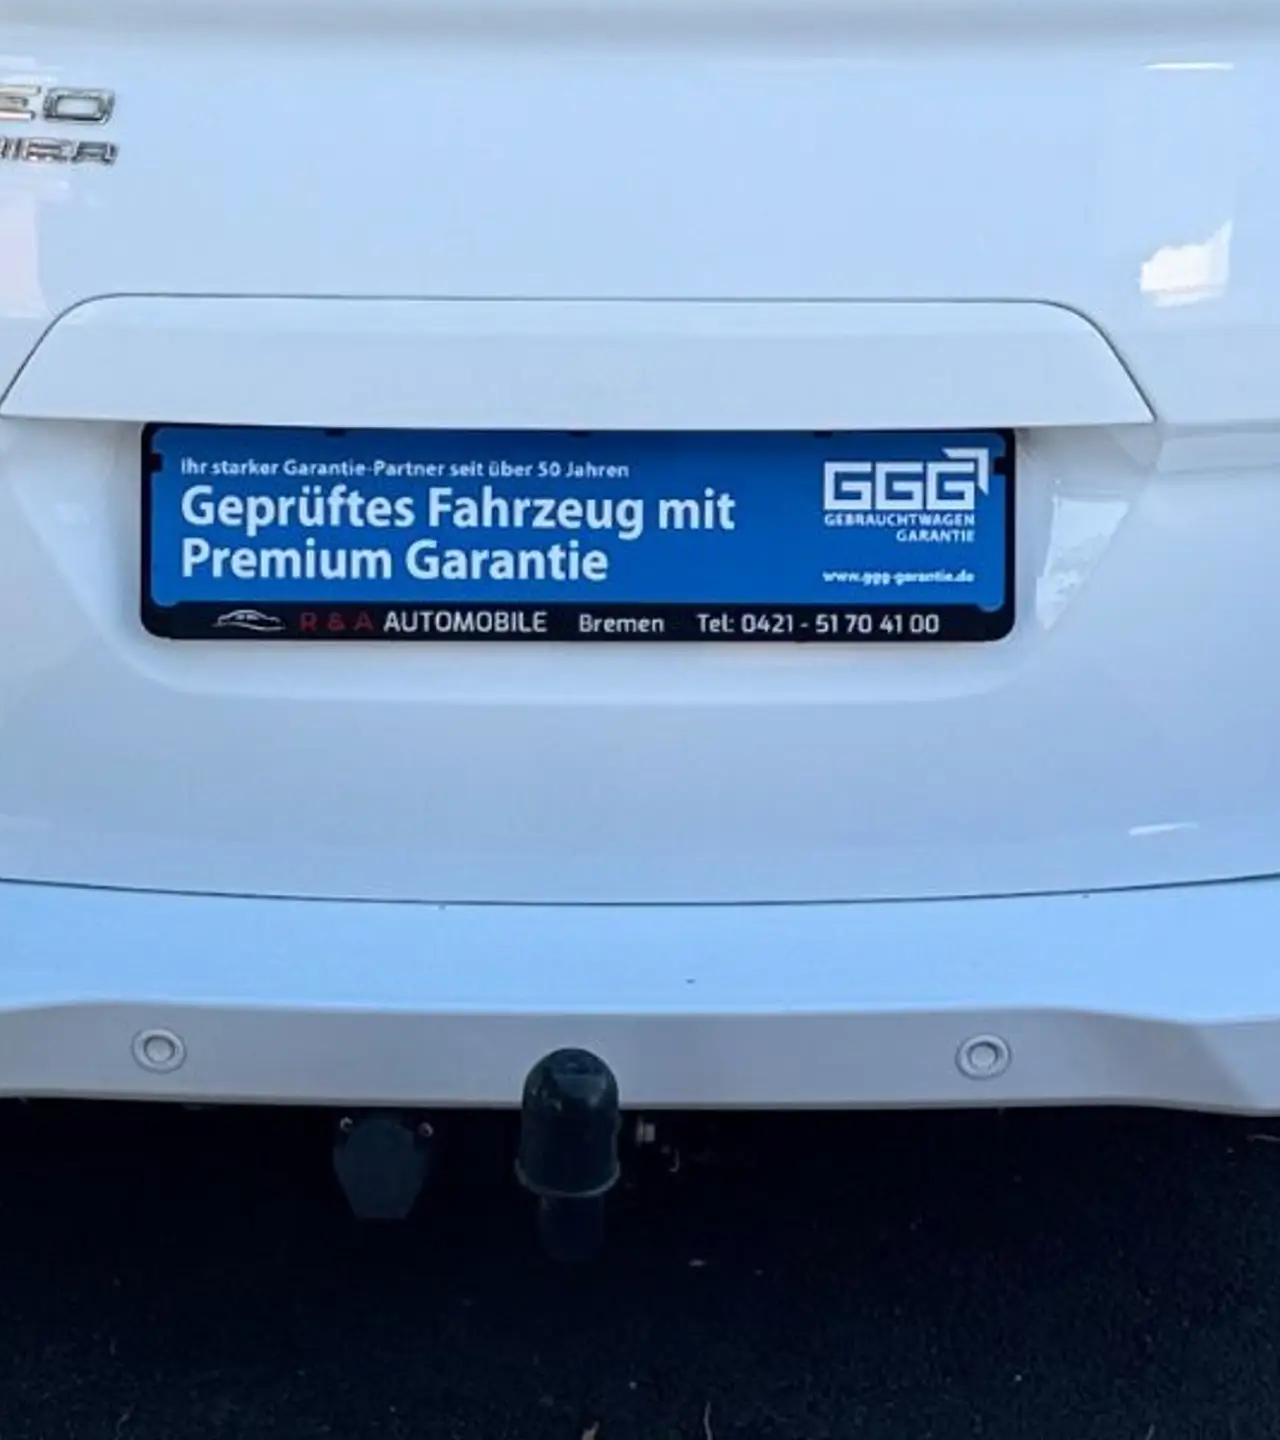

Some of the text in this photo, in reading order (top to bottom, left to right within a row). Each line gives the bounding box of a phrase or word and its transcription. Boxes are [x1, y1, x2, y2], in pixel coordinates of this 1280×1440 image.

[181, 458, 629, 478] Ihr starker Garantie-Partner seit über 50 Jahren
[824, 461, 975, 510] GGG
[181, 484, 736, 540] Geprüftes Fahrzeug mit
[824, 513, 975, 527] GEBRAUCHTWAGEN
[896, 529, 975, 543] GARANTIE
[182, 536, 608, 581] Premium Garantie
[822, 570, 975, 586] www.ggg-garantie.de
[300, 612, 318, 631] R
[326, 612, 345, 631] &
[354, 612, 373, 631] A
[383, 611, 547, 633] AUTOMOBILE
[579, 613, 665, 633] Bremen
[741, 614, 793, 633] 0421
